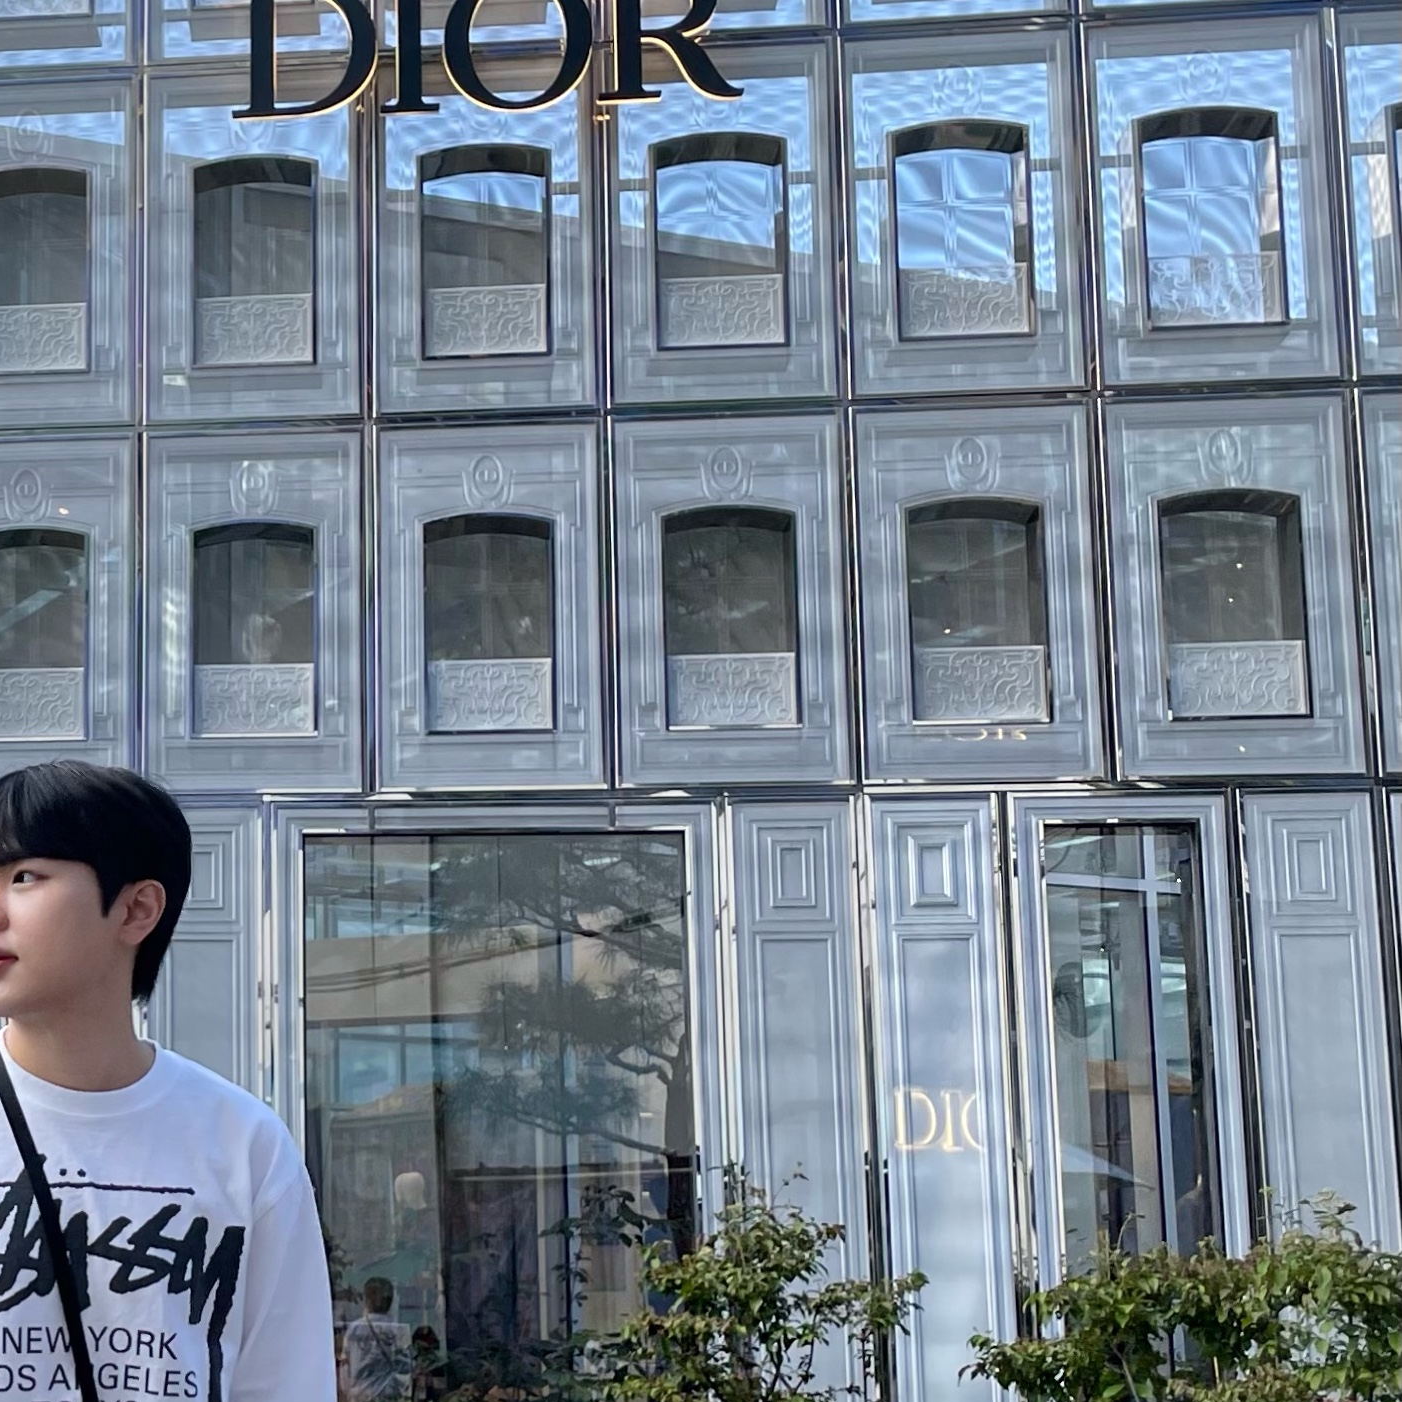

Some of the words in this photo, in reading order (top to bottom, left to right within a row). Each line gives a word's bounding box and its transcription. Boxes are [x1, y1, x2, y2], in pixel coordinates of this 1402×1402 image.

[232, 0, 745, 119] DIOR
[2, 1326, 72, 1354] NEW
[88, 1326, 178, 1360] YORK
[48, 1363, 198, 1398] AGELES
